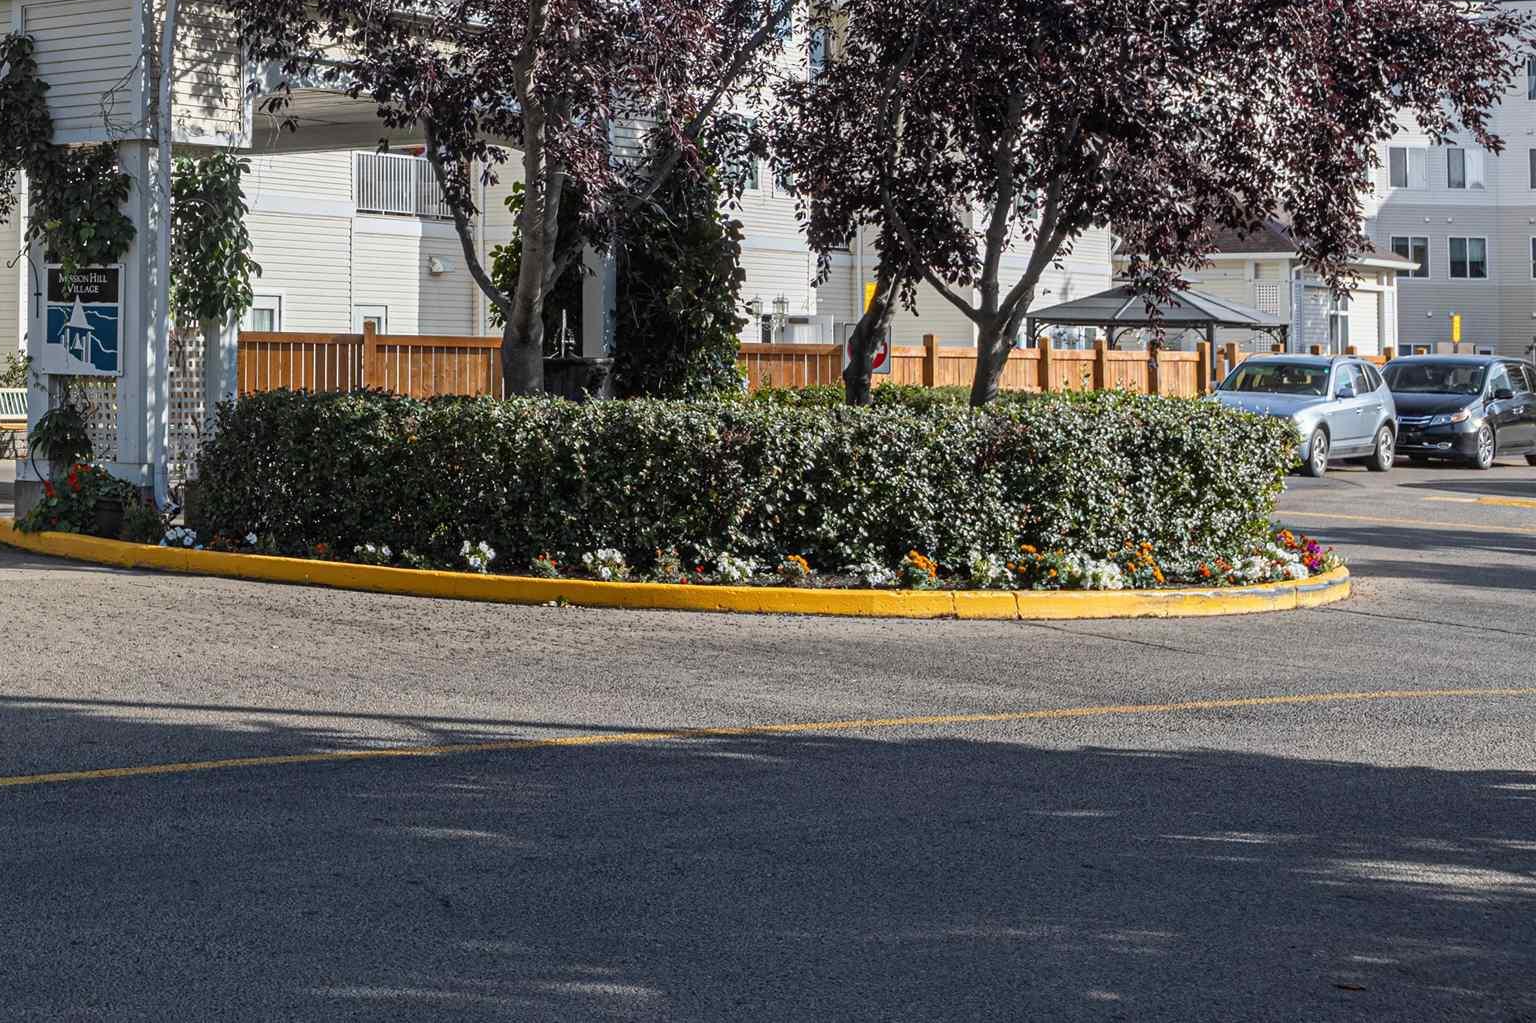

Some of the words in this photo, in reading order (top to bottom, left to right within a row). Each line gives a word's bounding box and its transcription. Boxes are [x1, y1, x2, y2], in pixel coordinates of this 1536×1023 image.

[58, 272, 89, 283] MSSION
[89, 272, 108, 283] HILL
[67, 283, 100, 293] VILLAGE
